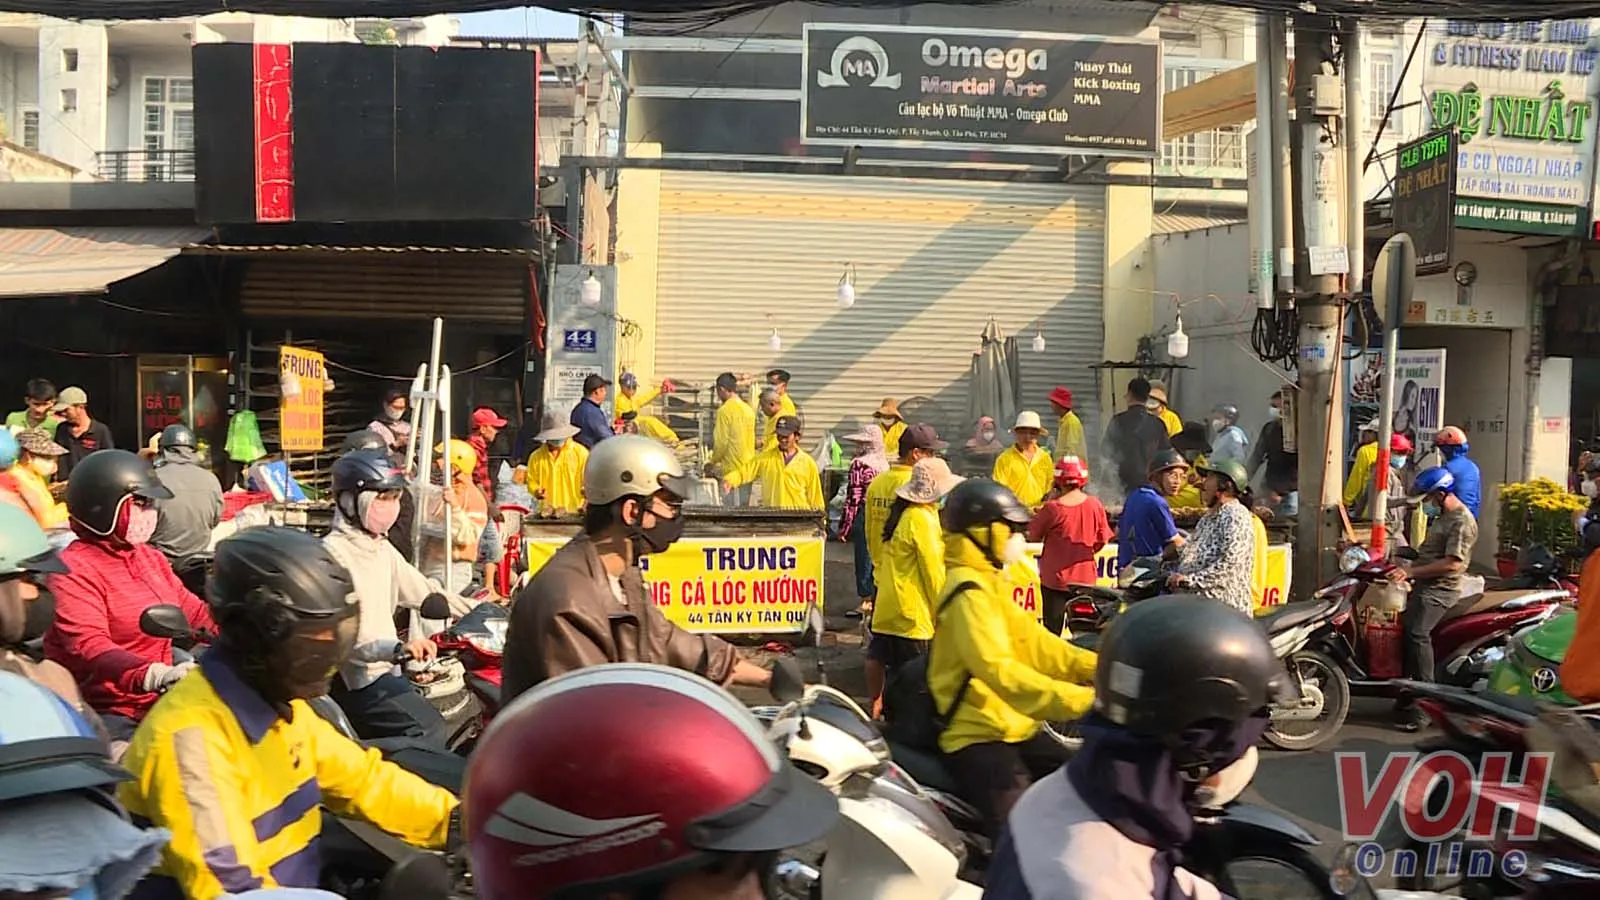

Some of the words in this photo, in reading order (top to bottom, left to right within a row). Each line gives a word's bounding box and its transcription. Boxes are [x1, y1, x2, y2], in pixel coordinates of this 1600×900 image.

[921, 38, 1048, 78] Omega
[1074, 61, 1105, 75] Muay
[1453, 45, 1522, 69] FITNESS
[1526, 49, 1567, 72] NAM
[921, 76, 995, 96] Martial
[1003, 79, 1048, 97] Arts
[1074, 77, 1099, 89] Kick
[1102, 79, 1141, 94] Boxing
[1073, 94, 1101, 105] MMA
[899, 103, 914, 116] Câu
[917, 103, 930, 118] lạc
[933, 103, 944, 119] bộ
[946, 104, 957, 116] Võ
[960, 105, 985, 120] Thuật
[987, 107, 1008, 119] MMA
[1016, 108, 1046, 123] Omega
[1048, 109, 1068, 122] Club
[1432, 81, 1481, 143] ĐỆ
[1489, 80, 1591, 141] NHẤT
[1474, 153, 1491, 173] CỤ
[1497, 155, 1539, 177] NGOẠI
[1545, 158, 1583, 181] NHẬP
[567, 331, 593, 344] 44
[1420, 387, 1439, 428] GYM
[702, 546, 796, 571] TRUNG
[682, 575, 706, 606] CÁ
[712, 575, 746, 606] LÓC
[753, 574, 817, 604] NƯỚNG
[688, 612, 703, 623] 44
[708, 609, 732, 623] TÂN
[757, 608, 781, 623] TÂN
